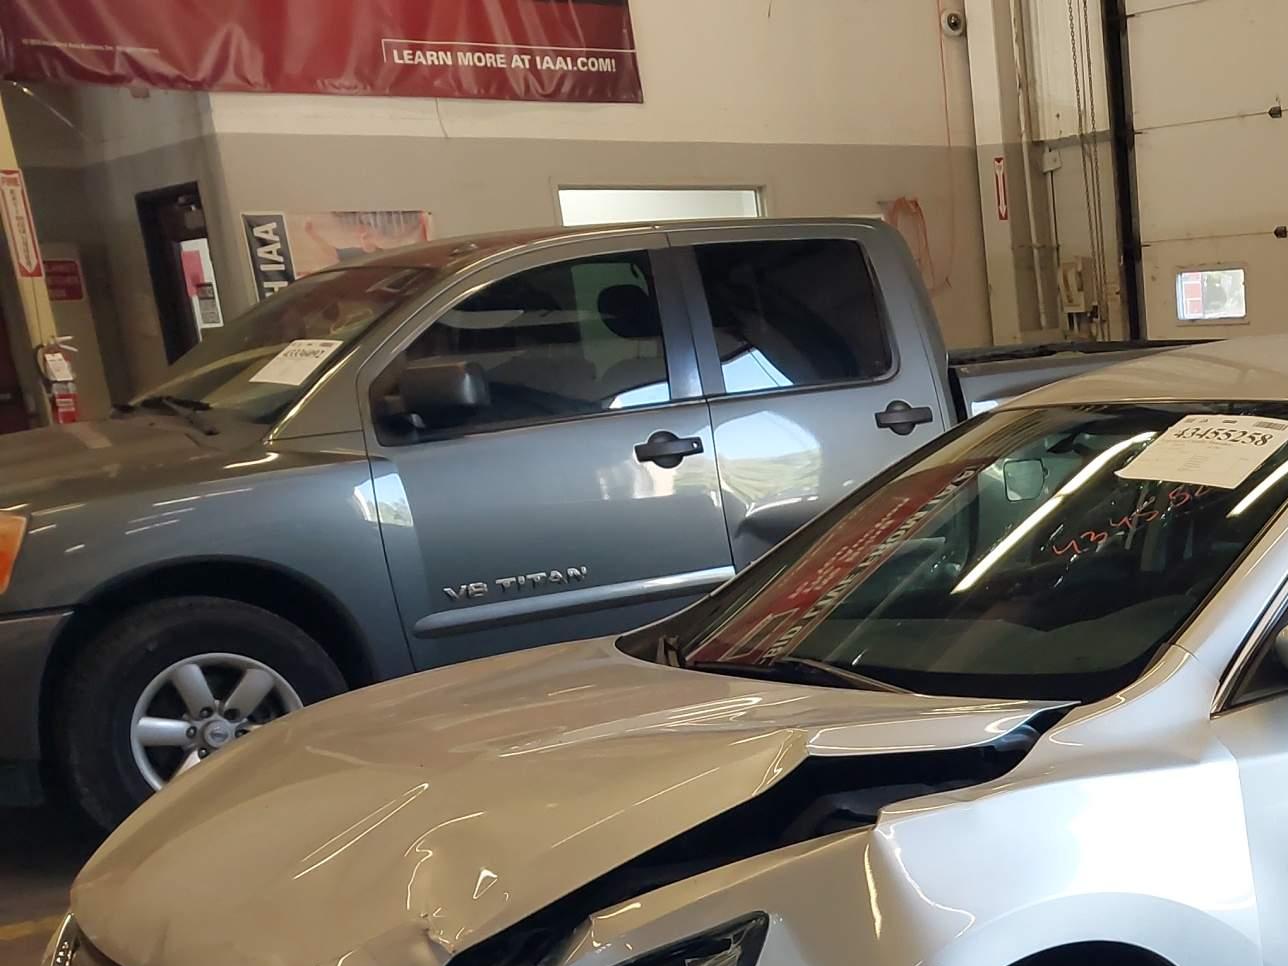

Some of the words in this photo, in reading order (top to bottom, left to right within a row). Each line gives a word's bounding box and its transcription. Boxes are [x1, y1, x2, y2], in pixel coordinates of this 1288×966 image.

[393, 49, 452, 65] LEARN
[456, 51, 507, 68] MORE
[511, 54, 531, 69] AT
[536, 56, 617, 73] IAAI.COM!
[252, 222, 286, 271] IAA
[1173, 426, 1274, 447] 43455258
[495, 564, 588, 592] TITAN
